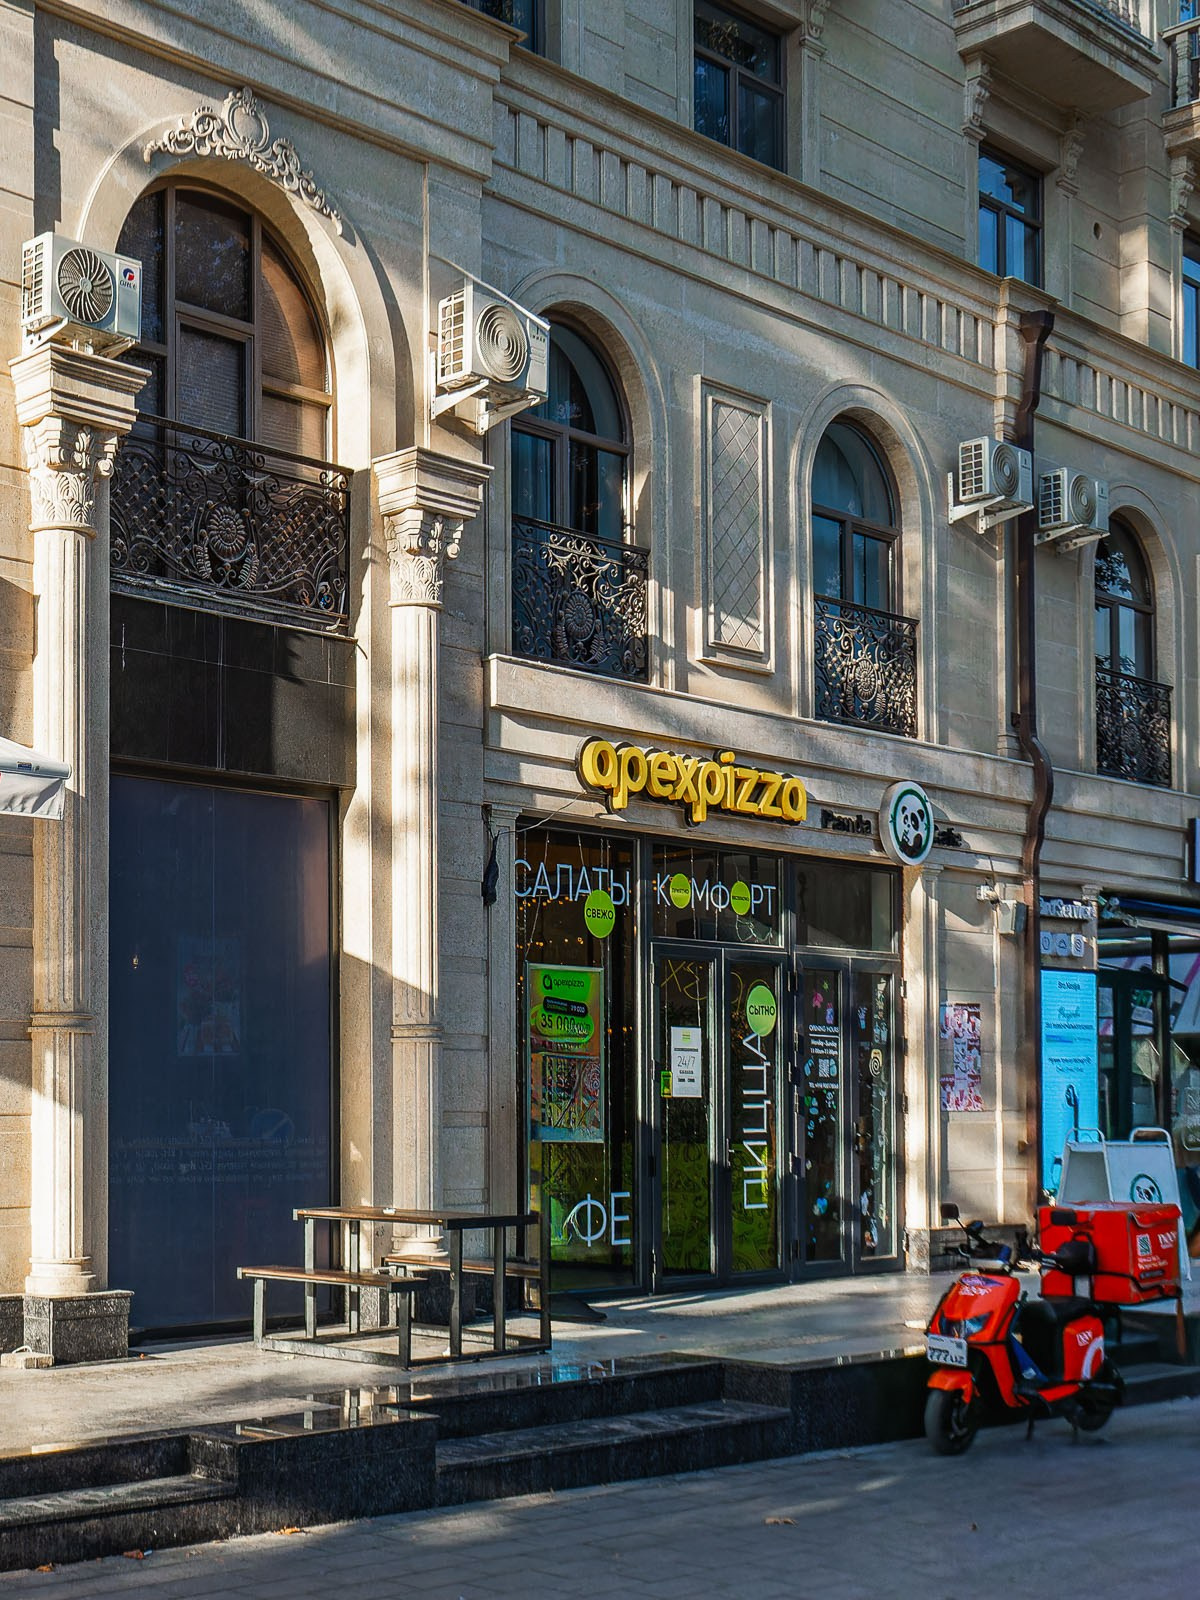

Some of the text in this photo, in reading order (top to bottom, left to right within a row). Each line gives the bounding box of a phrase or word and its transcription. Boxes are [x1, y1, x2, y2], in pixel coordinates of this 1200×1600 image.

[579, 738, 807, 823] apexpizza
[515, 859, 630, 906] САЛАТЫ
[657, 873, 777, 916] КМФРТ
[585, 907, 615, 921] СВЕЖО
[541, 1013, 553, 1029] 35
[748, 1005, 776, 1016] СЫТНО
[677, 1055, 696, 1069] 24/7
[742, 1032, 771, 1210] ПИЦЦА
